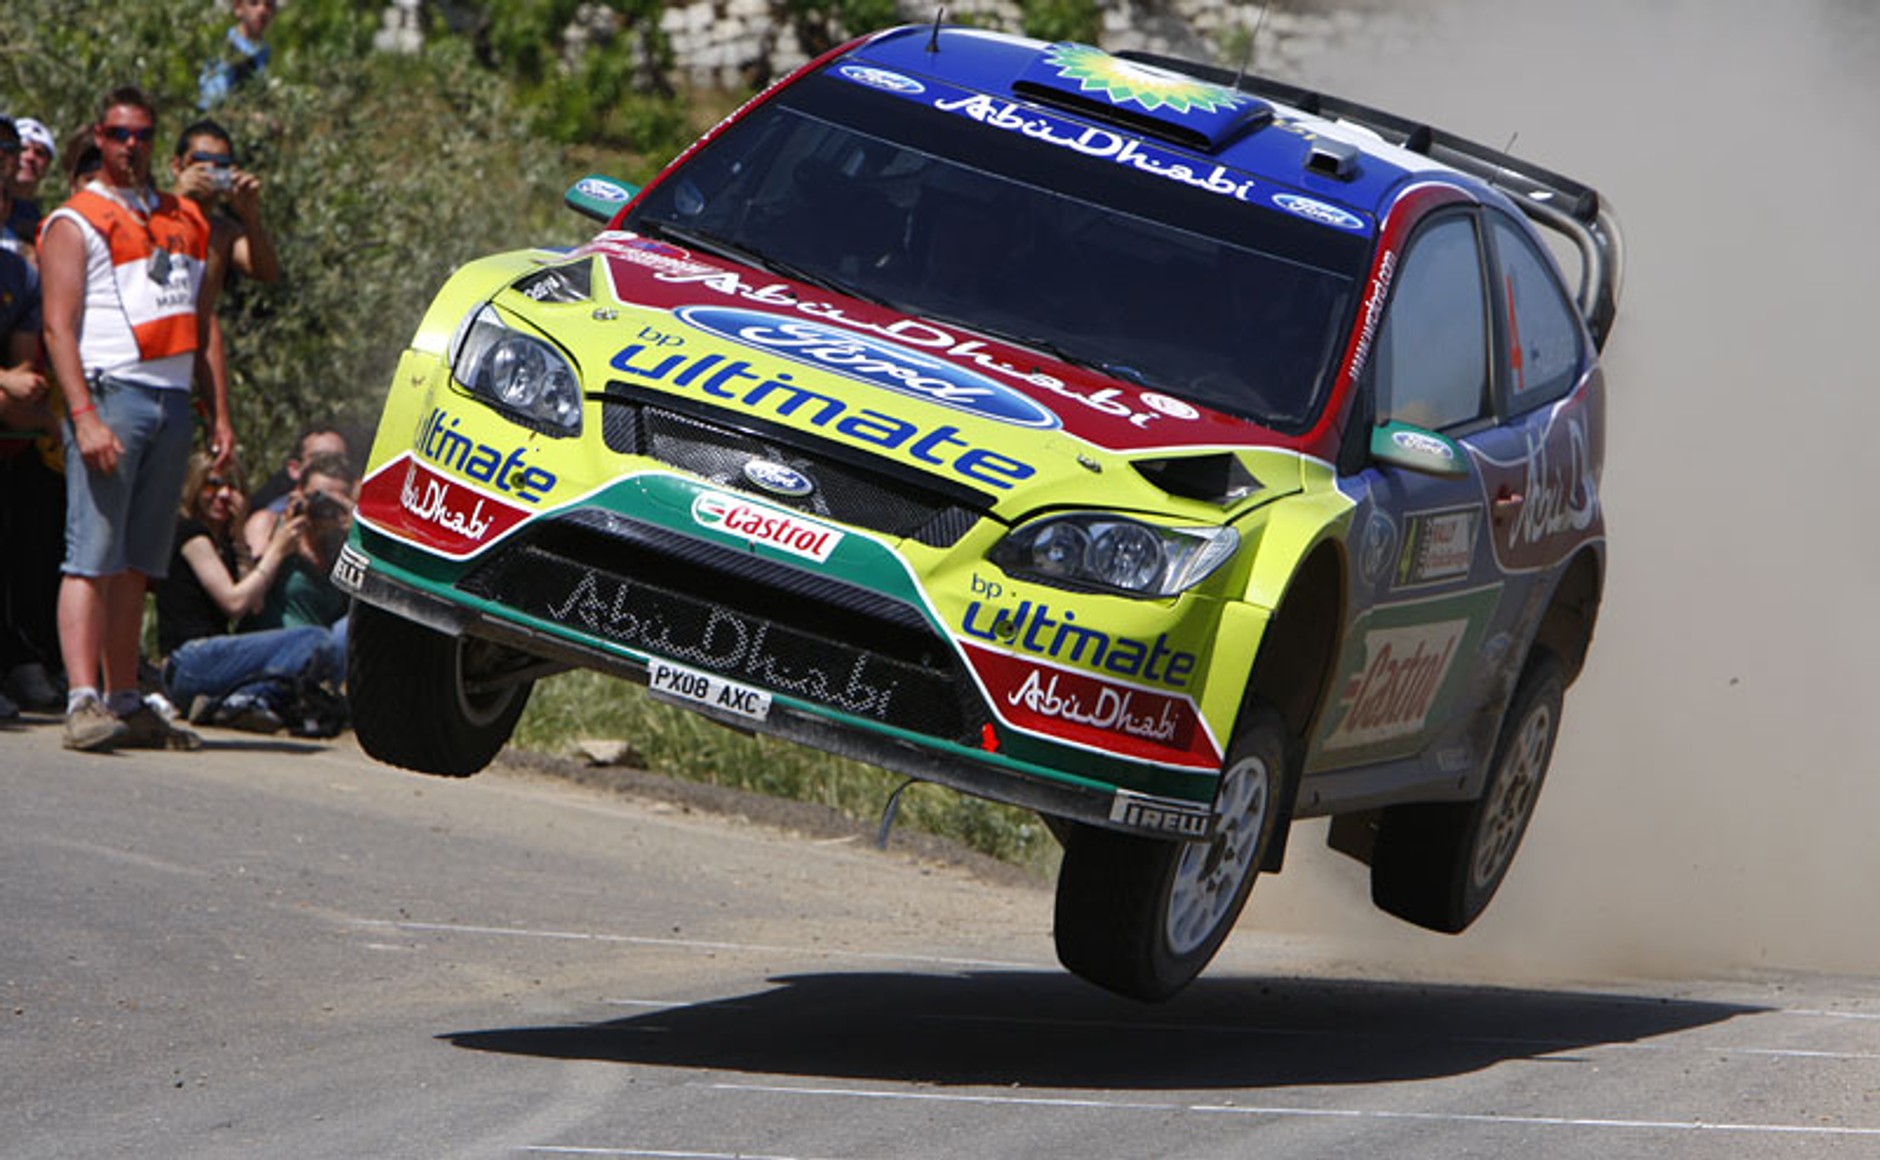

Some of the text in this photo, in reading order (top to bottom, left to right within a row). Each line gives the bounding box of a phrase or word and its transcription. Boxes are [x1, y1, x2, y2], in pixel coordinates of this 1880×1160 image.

[1285, 198, 1354, 224] Ford
[638, 327, 684, 347] bp
[740, 324, 995, 403] Ford
[609, 344, 1037, 490] ultimate
[752, 465, 802, 489] Ford
[724, 505, 831, 556] Castrol
[971, 573, 1003, 599] bp
[962, 601, 1195, 687] ultimate
[654, 664, 761, 715] PX08 AXC
[1346, 635, 1457, 733] Castrol
